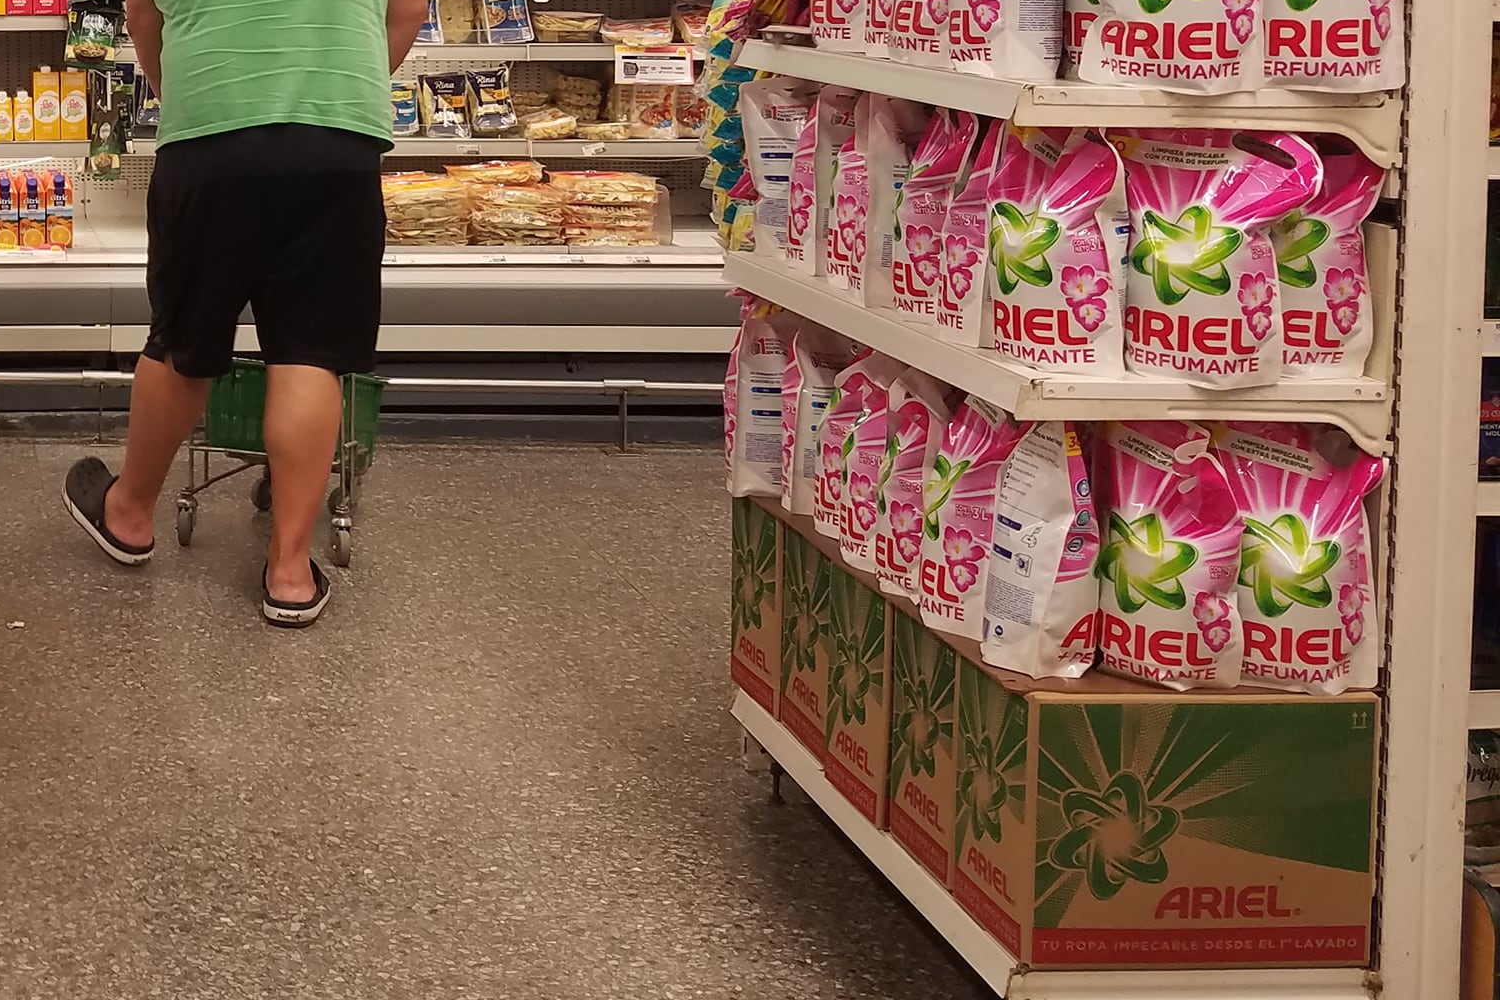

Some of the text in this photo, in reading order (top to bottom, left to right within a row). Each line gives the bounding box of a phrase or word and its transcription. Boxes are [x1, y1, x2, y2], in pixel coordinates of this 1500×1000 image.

[1101, 19, 1241, 61] ARIEL
[434, 81, 455, 90] Rina
[476, 75, 497, 85] Rina
[1144, 153, 1196, 165] CON EXTRA DE
[1152, 146, 1225, 159] LIMPIEZA IMPECABLE
[50, 194, 70, 204] citric
[993, 299, 1088, 345] RIEL
[1125, 307, 1256, 356] ARIEL
[739, 635, 771, 675] ARIEL
[1243, 620, 1350, 665] RIEL
[793, 679, 825, 720] ARIEL
[836, 730, 872, 776] ARIEL
[904, 780, 944, 833] ARIEL
[967, 846, 1013, 901] ARIEL
[1154, 886, 1292, 920] ARIEL
[1040, 937, 1358, 952] TU ROPA IMPECABLE DESDE EL LAVADO
